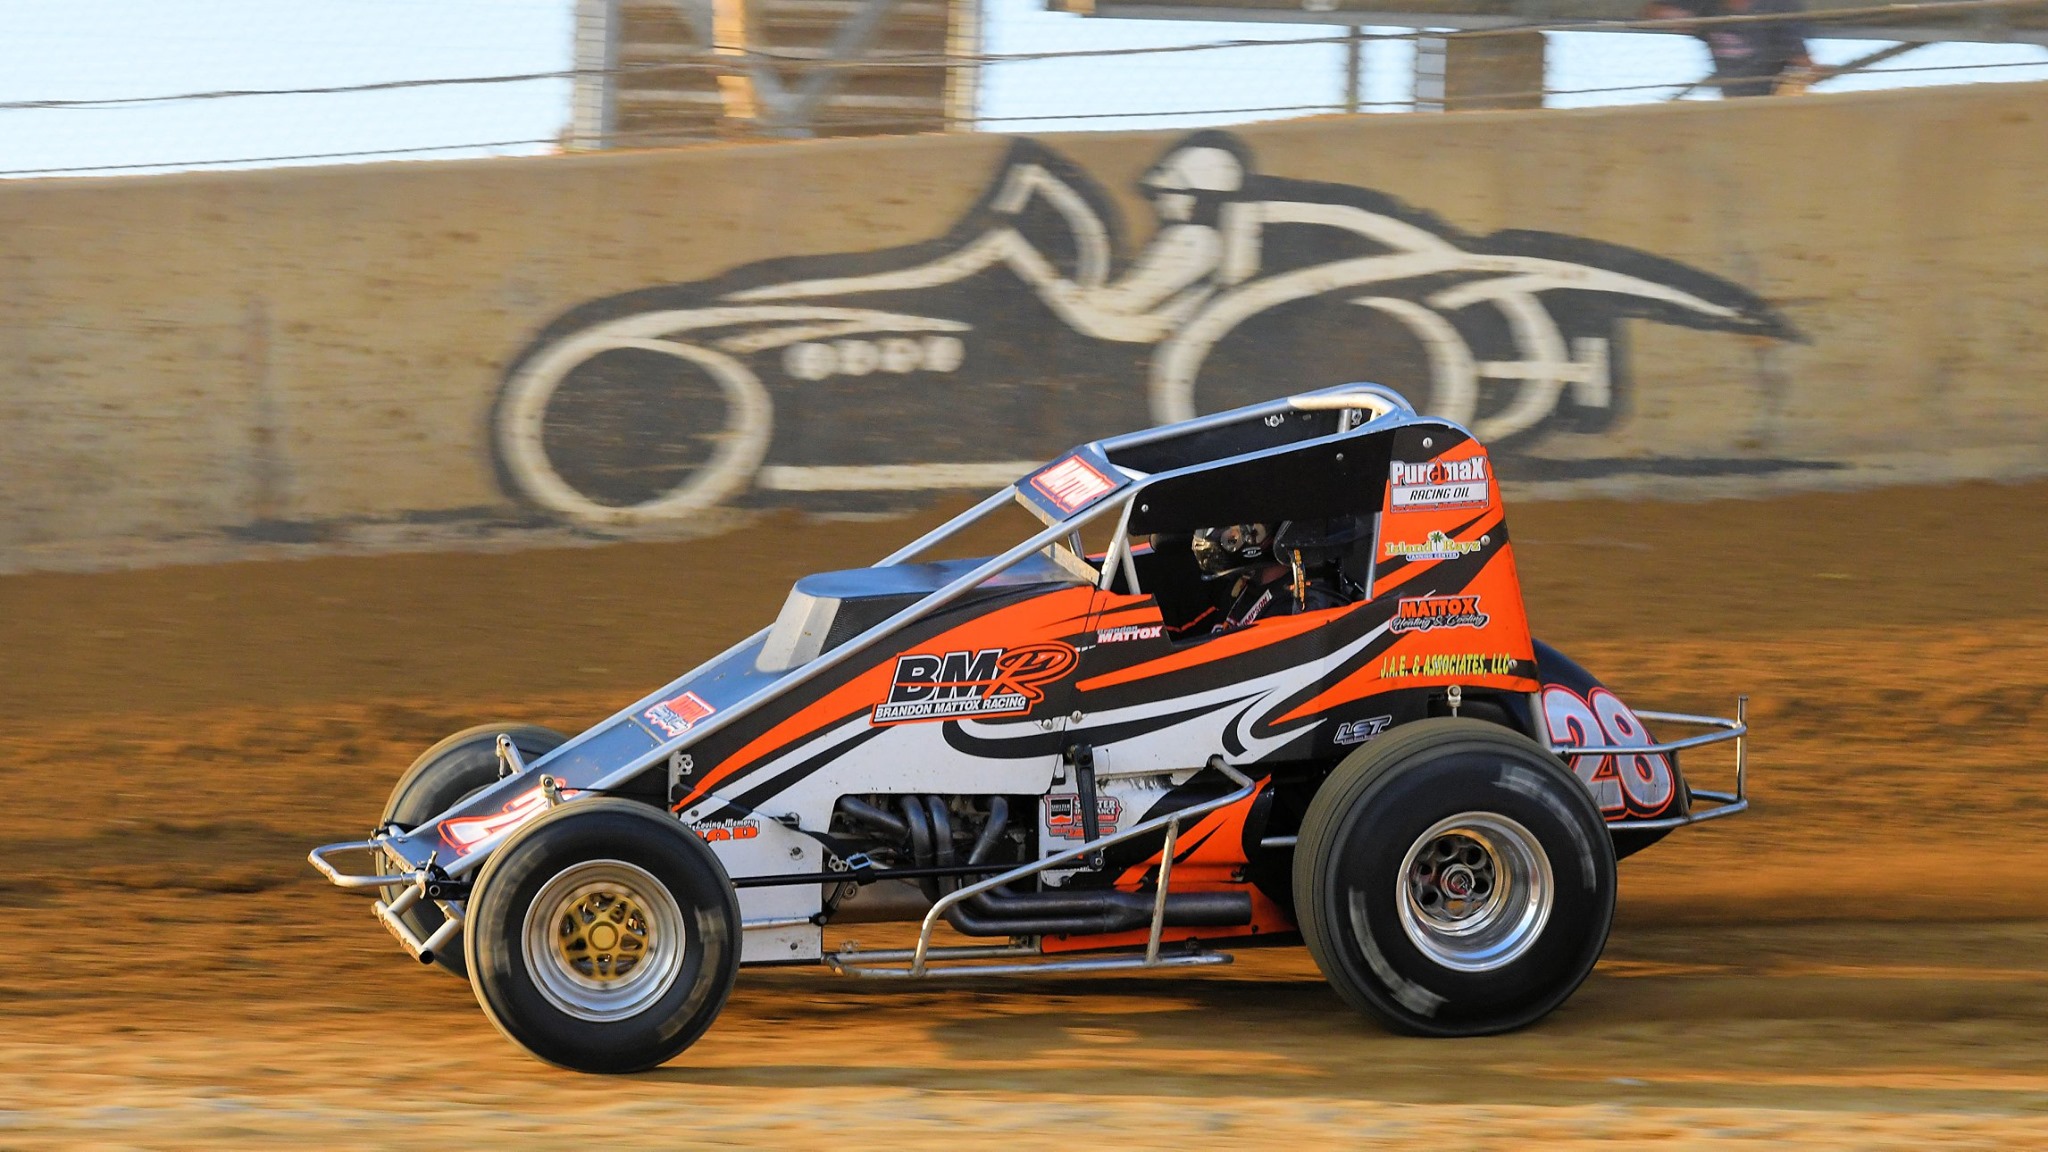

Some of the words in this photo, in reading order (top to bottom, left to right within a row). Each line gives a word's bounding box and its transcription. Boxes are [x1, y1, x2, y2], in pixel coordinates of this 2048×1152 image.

[1409, 488, 1451, 500] RACING
[1453, 486, 1470, 498] OIL
[1386, 541, 1432, 554] Island
[1443, 540, 1480, 554] Rayz
[1401, 598, 1476, 618] MATTOX
[1391, 616, 1432, 631] Heating
[1433, 615, 1446, 627] &
[1446, 613, 1488, 627] Cooling
[1097, 626, 1163, 644] MATTOX
[1380, 655, 1409, 679] J.A.E.
[1412, 655, 1421, 677] &
[1423, 653, 1488, 678] ASSOCIATES,
[1491, 652, 1511, 675] LLC
[875, 705, 932, 718] BRANDON
[934, 700, 980, 714] MATTOX
[984, 696, 1026, 709] RACING
[1337, 719, 1389, 740] LST
[1543, 685, 1675, 817] 28
[1075, 800, 1116, 809] STER
